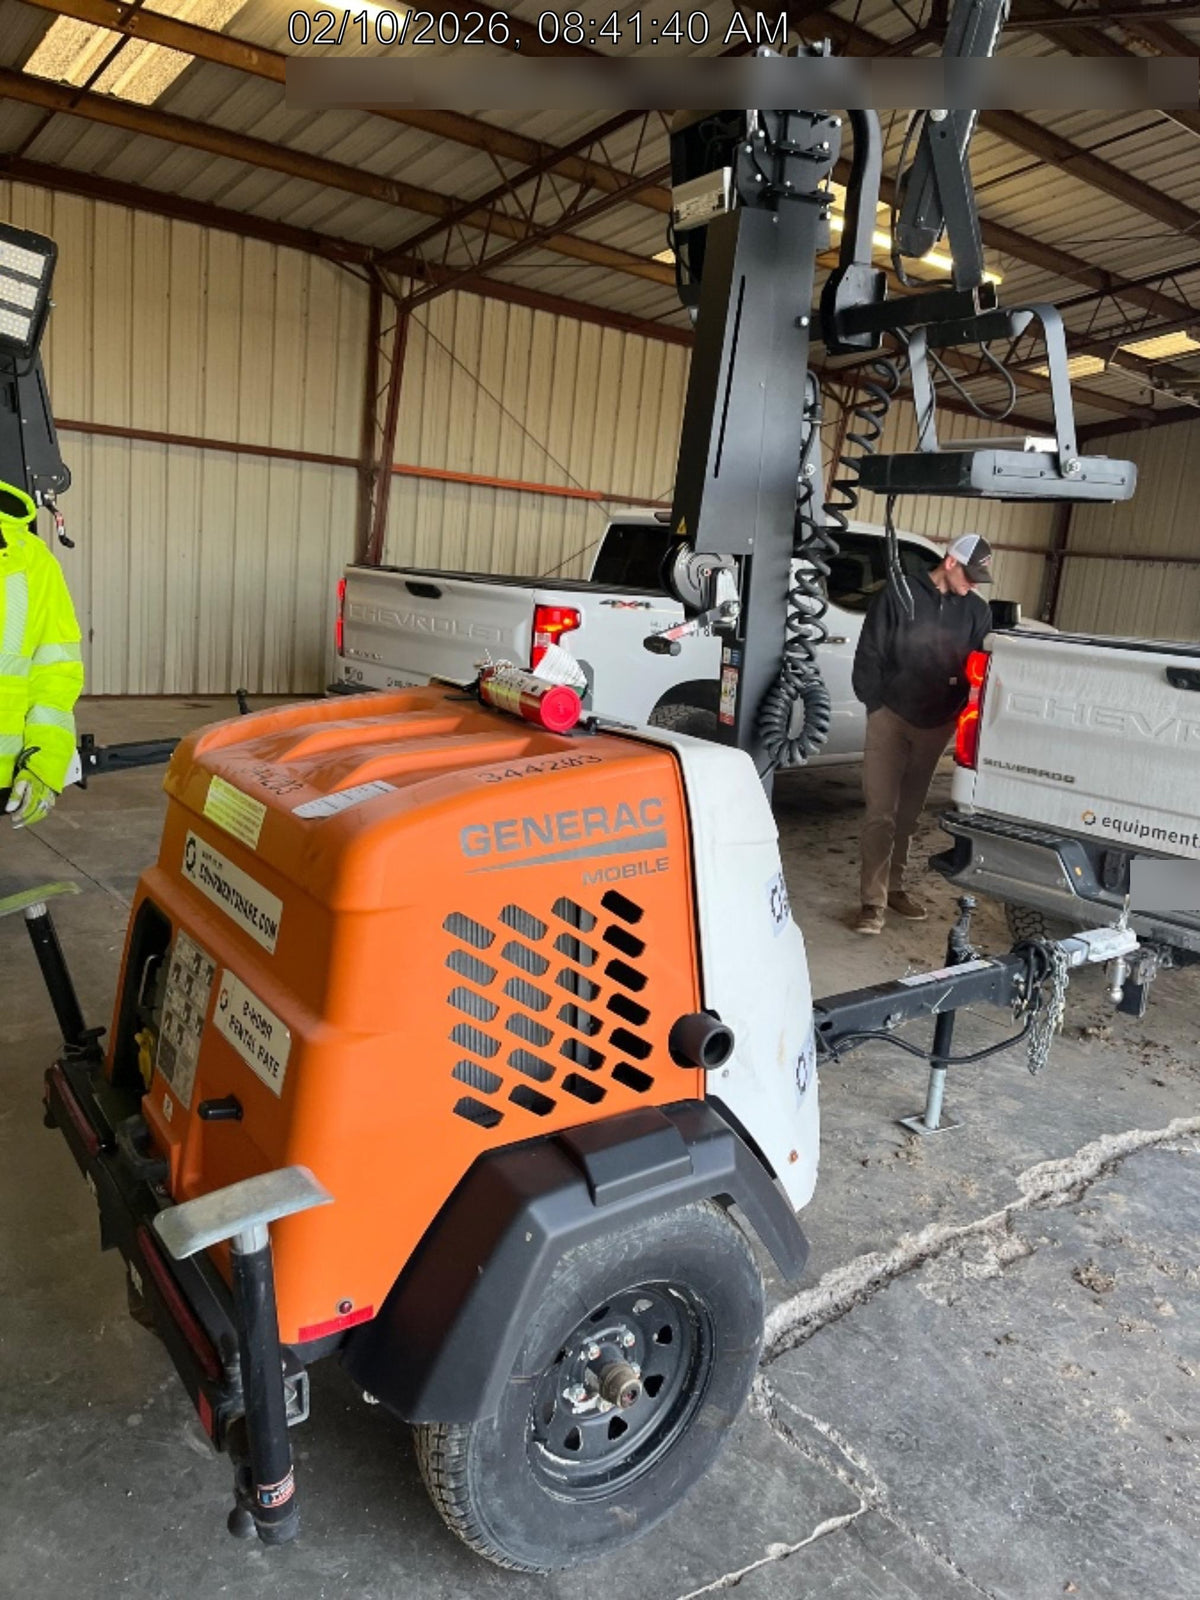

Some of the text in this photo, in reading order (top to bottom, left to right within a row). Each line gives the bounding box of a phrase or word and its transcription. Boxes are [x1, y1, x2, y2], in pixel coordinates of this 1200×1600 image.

[349, 603, 516, 644] CHEVROLET
[983, 757, 1076, 784] SILVERADO
[459, 797, 666, 858] GENERAC
[1101, 816, 1200, 849] equipment
[581, 856, 670, 887] MOBILE
